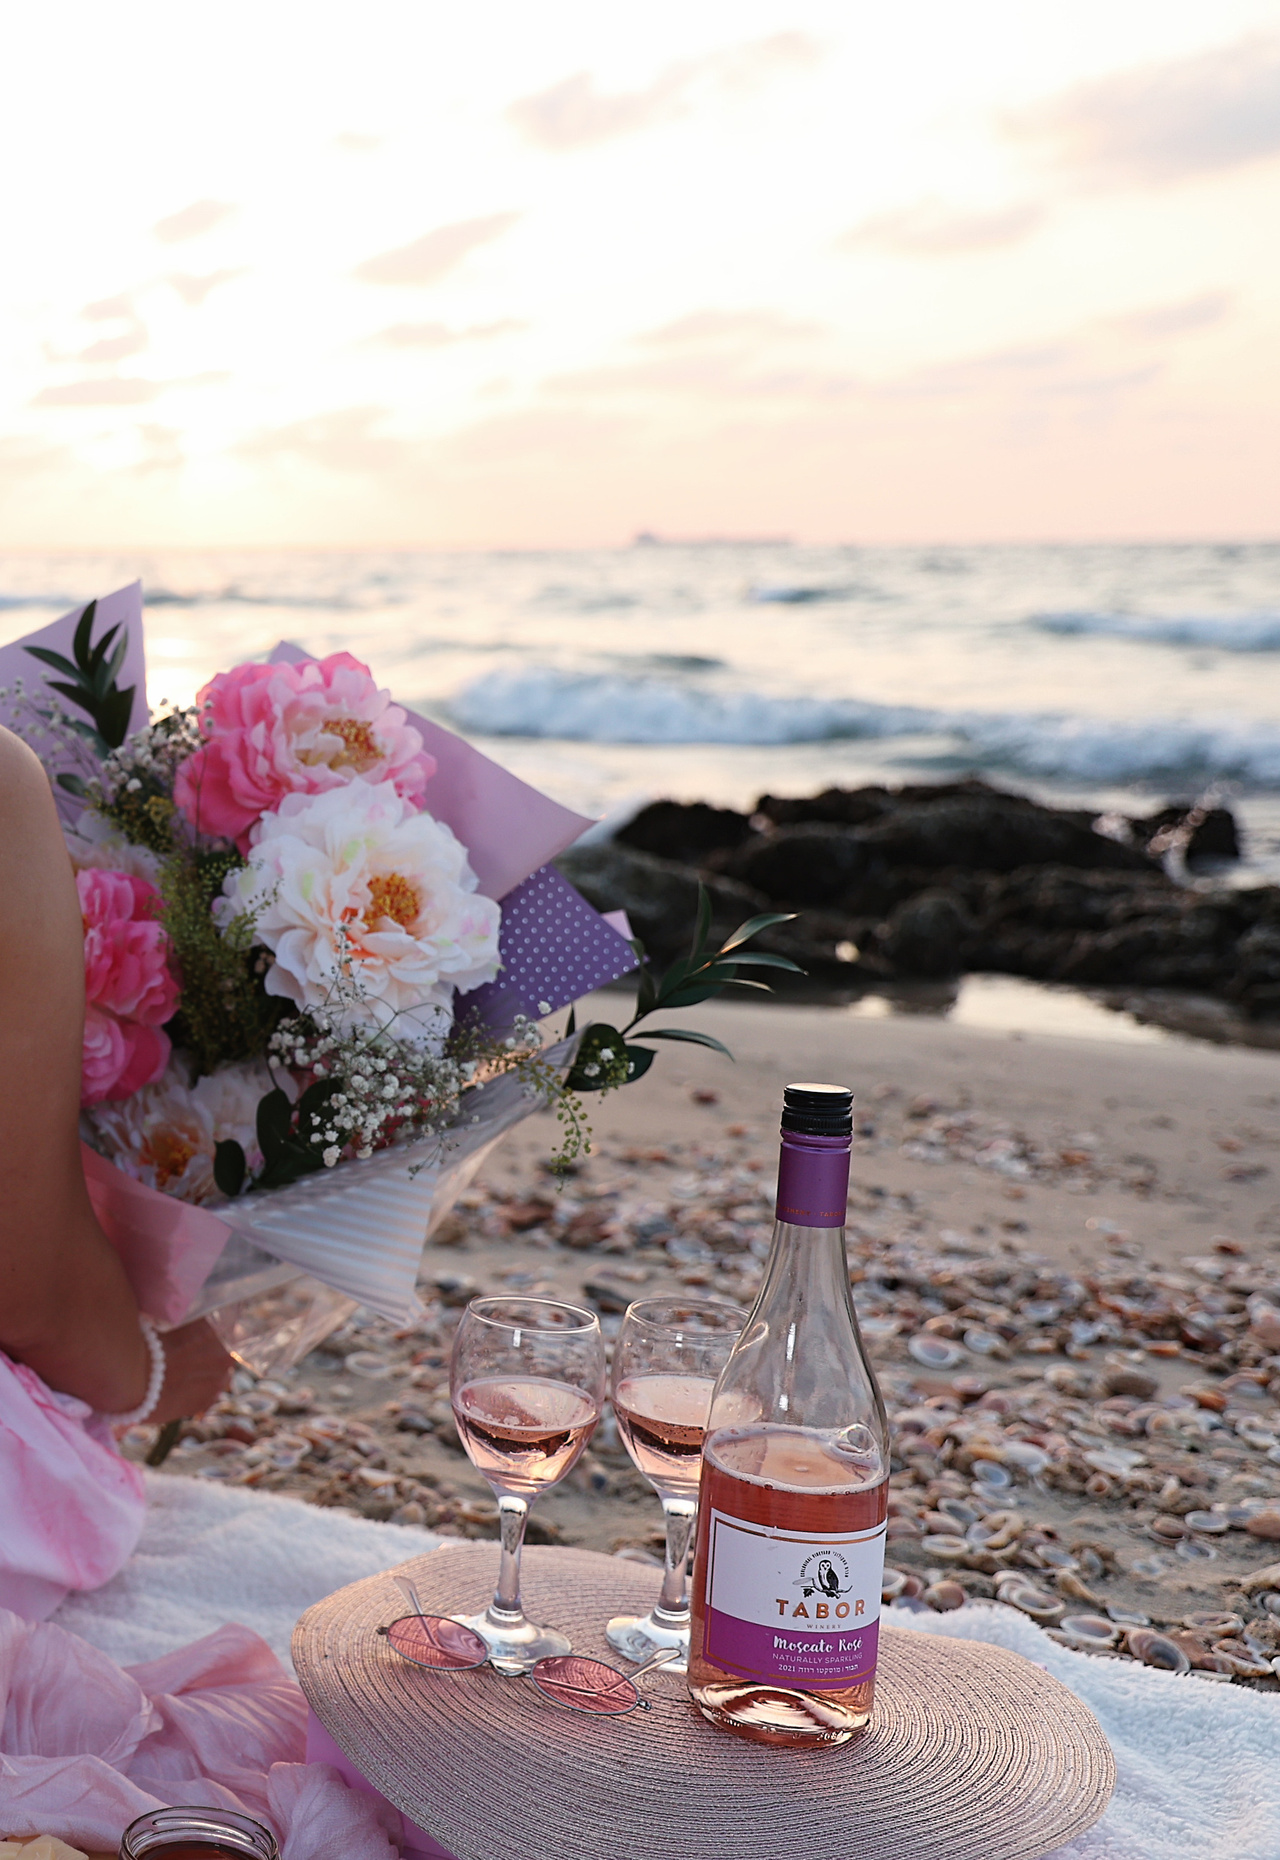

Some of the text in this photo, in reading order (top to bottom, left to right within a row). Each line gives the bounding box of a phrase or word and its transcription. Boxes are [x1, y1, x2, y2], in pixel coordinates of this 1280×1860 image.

[775, 1598, 865, 1619] TABOR
[773, 1635, 834, 1654] Moscato
[772, 1652, 863, 1664] NATURALLY SPARKLING
[778, 1664, 796, 1672] 2021
[816, 1667, 841, 1675] מוסקטו
